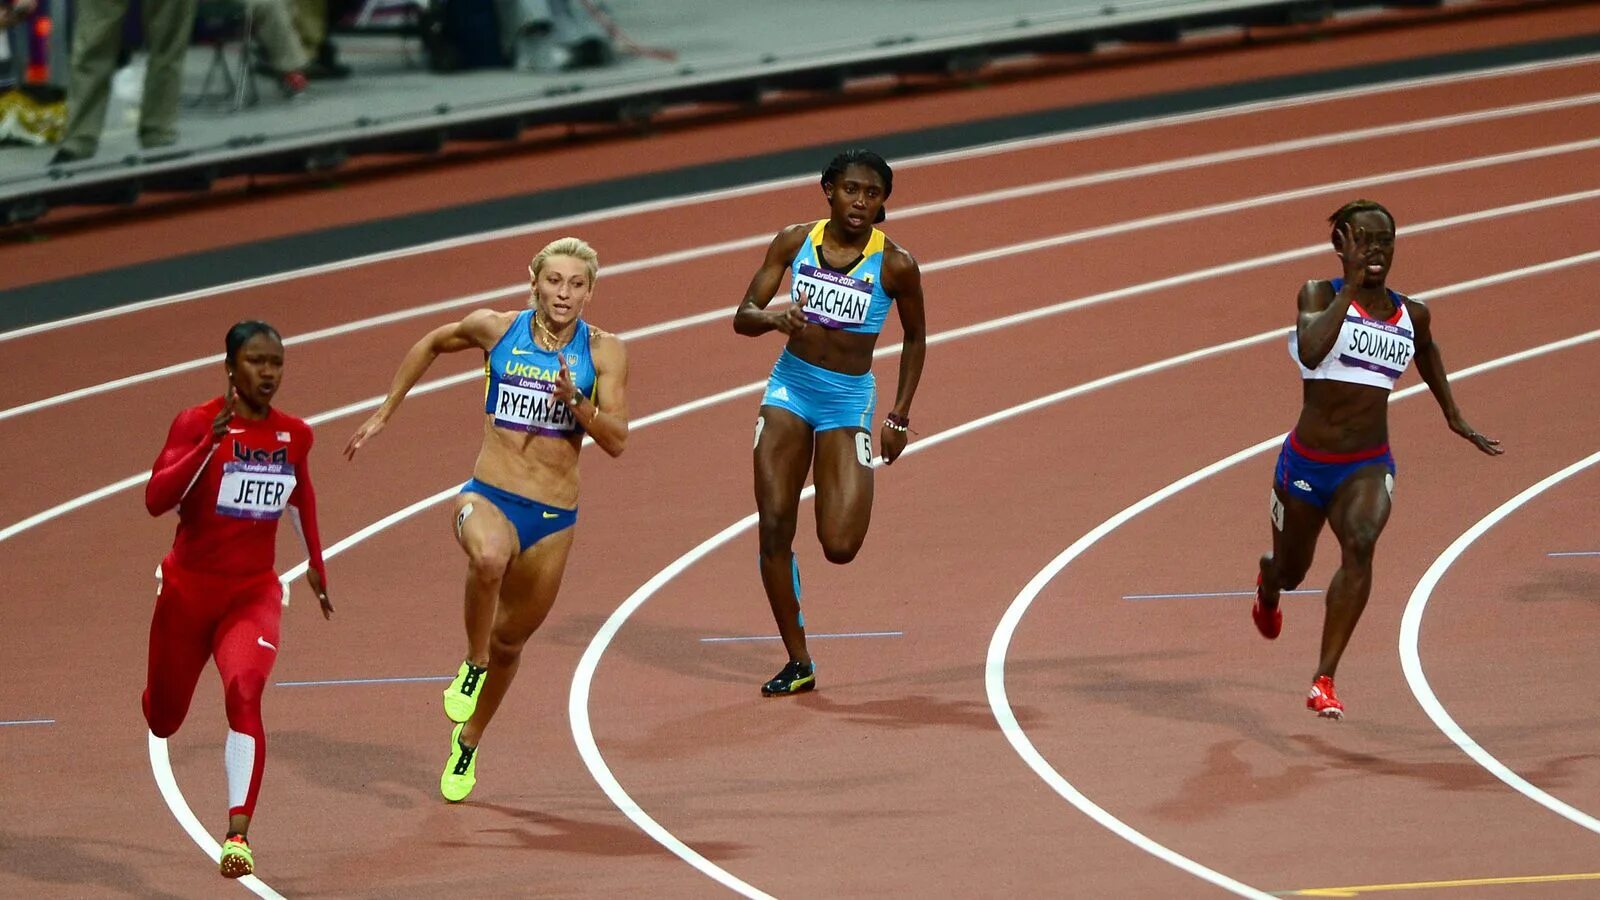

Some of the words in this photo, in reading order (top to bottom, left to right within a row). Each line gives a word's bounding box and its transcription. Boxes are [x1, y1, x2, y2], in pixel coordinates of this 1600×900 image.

[813, 269, 838, 283] London
[838, 276, 855, 287] 2012
[795, 280, 867, 321] STRACHAN
[1362, 318, 1384, 330] London
[1349, 328, 1411, 366] SOUMARE
[505, 360, 577, 385] UKRAIE
[519, 378, 546, 391] London
[233, 439, 288, 463] USA
[864, 438, 871, 463] 5
[244, 463, 267, 473] London
[234, 480, 285, 506] JETER
